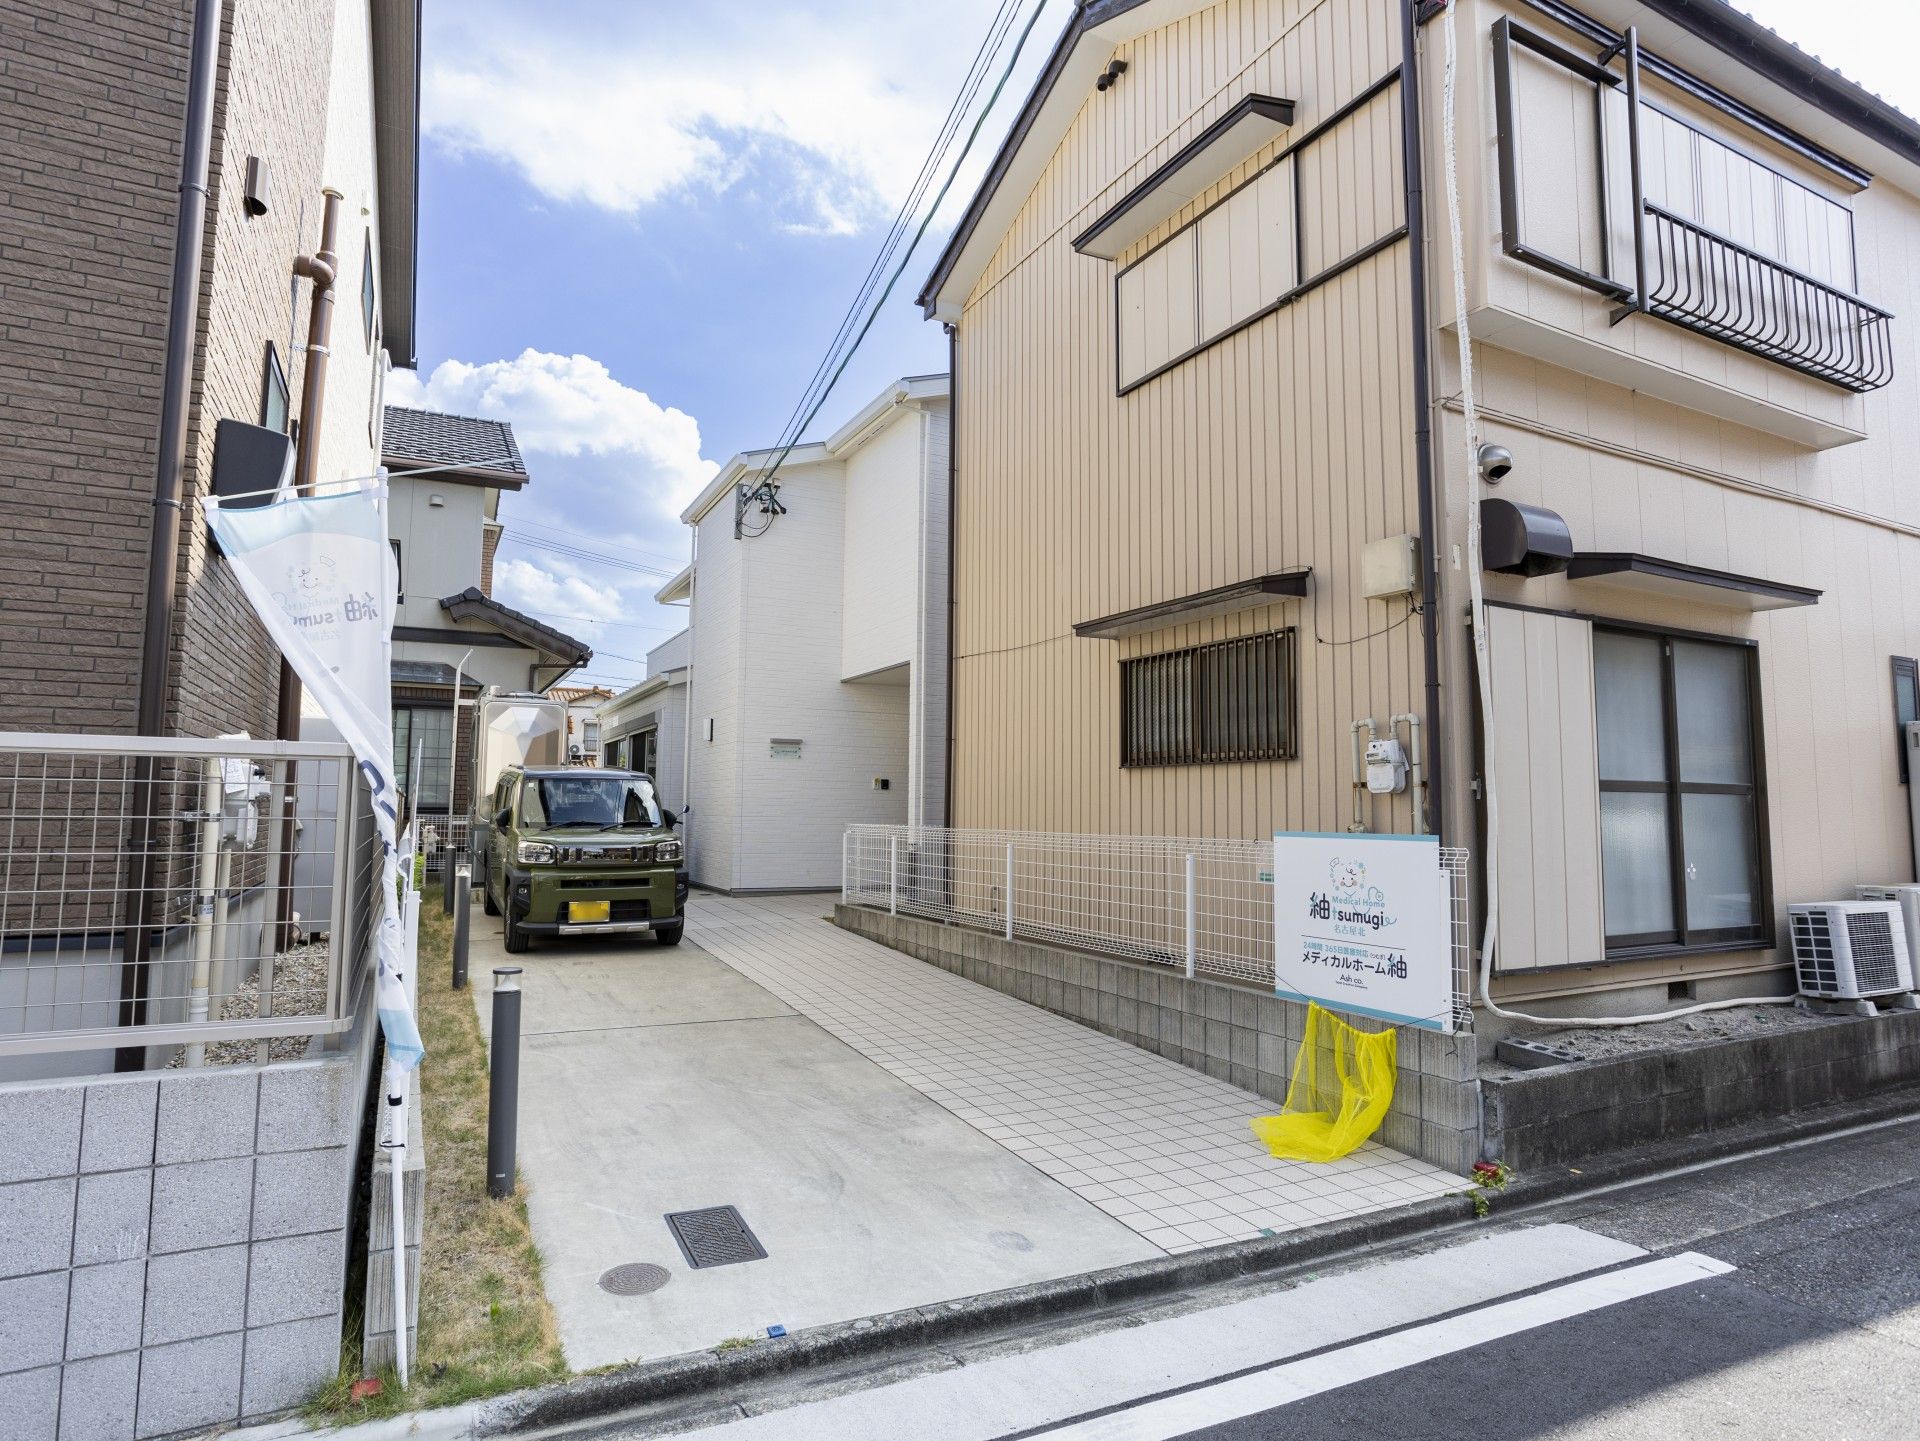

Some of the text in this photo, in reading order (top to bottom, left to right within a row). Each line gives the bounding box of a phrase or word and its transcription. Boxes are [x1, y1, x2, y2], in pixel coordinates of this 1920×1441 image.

[1309, 891, 1330, 920] 紬
[1332, 895, 1386, 908] Medical Home
[1334, 923, 1366, 937] 名古屋北
[1339, 973, 1353, 983] Ash
